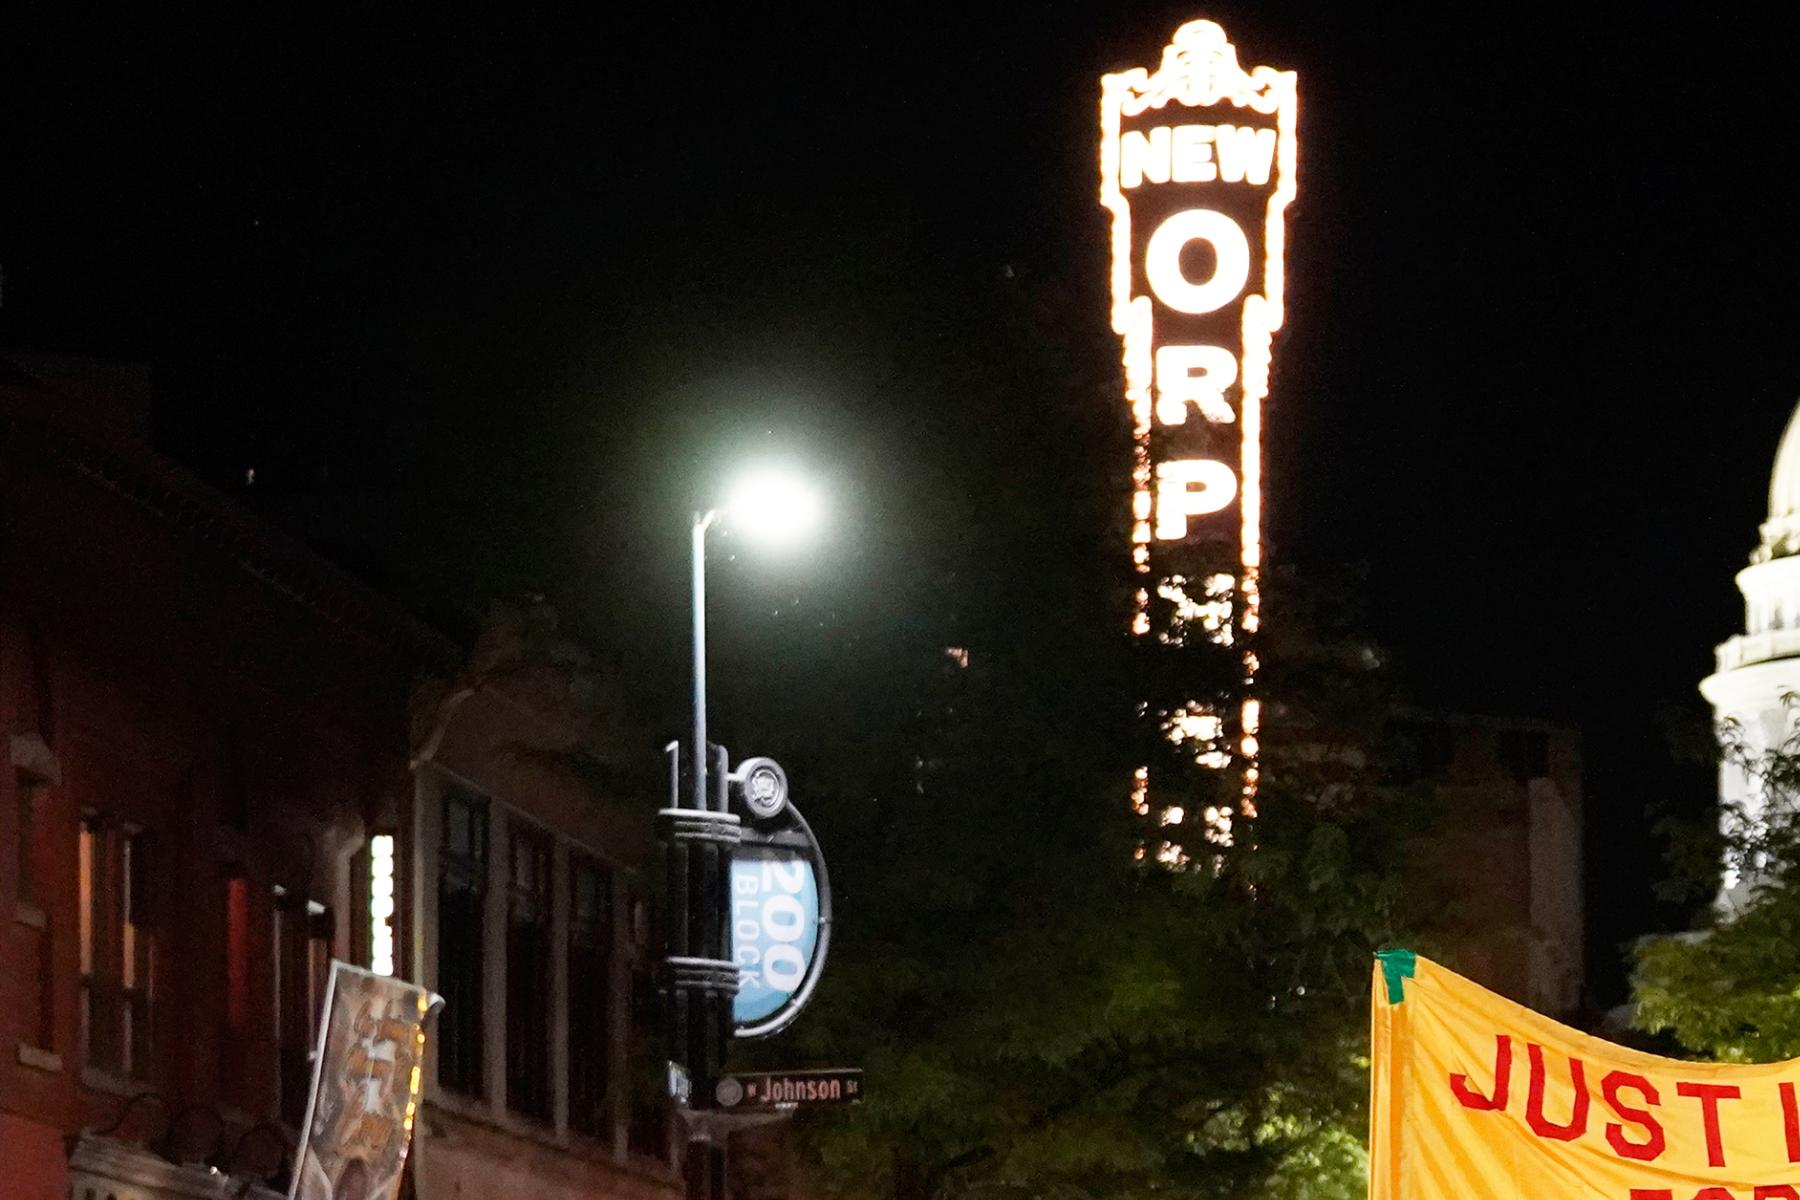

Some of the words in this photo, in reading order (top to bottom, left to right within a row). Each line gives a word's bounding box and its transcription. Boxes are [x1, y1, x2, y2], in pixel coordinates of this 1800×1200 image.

[1120, 124, 1277, 189] NEW
[735, 873, 761, 992] BLOCK
[761, 861, 806, 993] 200
[760, 1076, 842, 1103] Johnson
